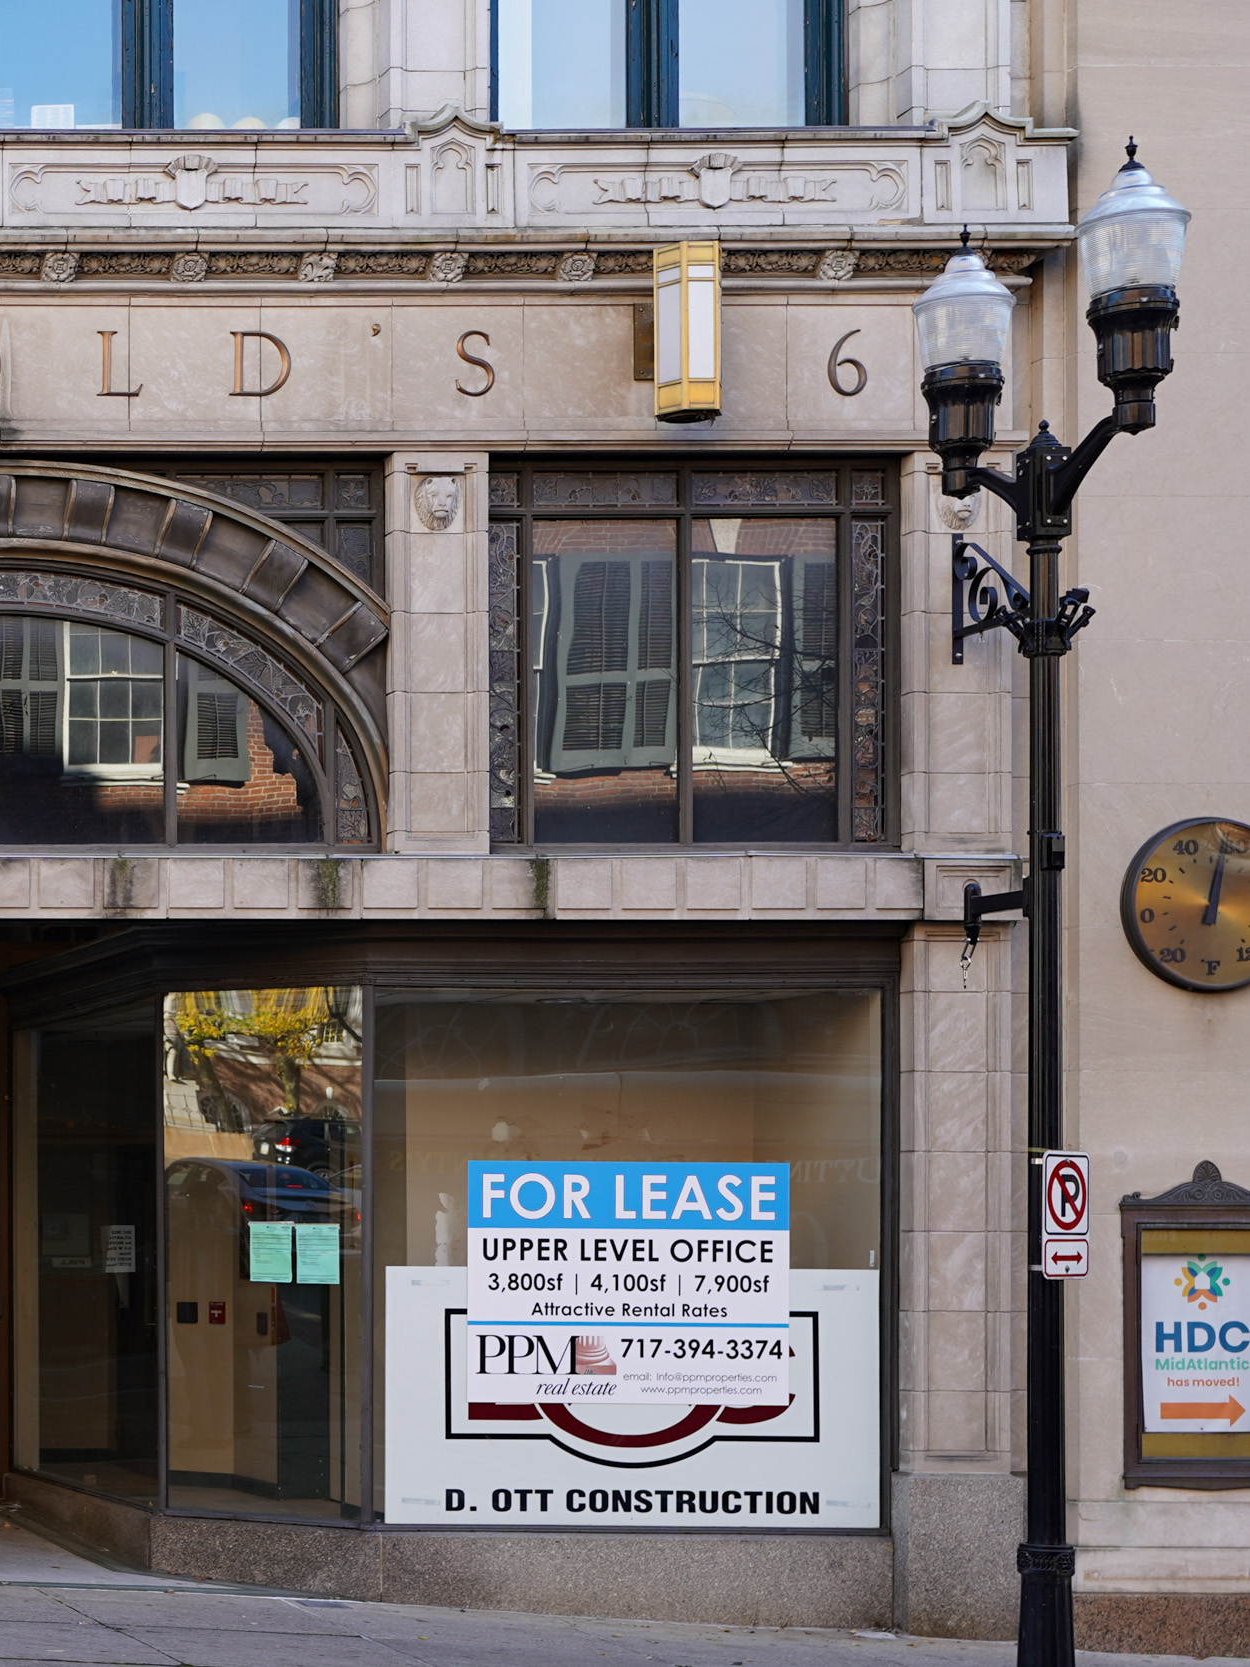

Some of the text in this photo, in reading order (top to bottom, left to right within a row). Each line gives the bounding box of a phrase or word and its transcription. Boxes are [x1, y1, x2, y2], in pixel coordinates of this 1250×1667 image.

[827, 328, 868, 397] 6
[1172, 839, 1199, 856] 40
[1140, 867, 1167, 883] 20
[1140, 908, 1155, 924] 0
[482, 1172, 776, 1221] FOR LEASE
[482, 1237, 773, 1264] UPPER LEVEL OFFICE
[488, 1273, 770, 1295] 3,800sf 4,100sf 7,900sf
[531, 1302, 728, 1318] Attractive Rental Rates
[1155, 1321, 1250, 1354] HDC
[476, 1334, 580, 1375] PPM
[620, 1338, 783, 1360] 717-394-3374
[1155, 1357, 1250, 1371] MidAtlantic
[536, 1377, 618, 1396] real estate
[622, 1372, 778, 1384] email: Info@ppmproperties.com
[1167, 1376, 1240, 1388] has moved!
[640, 1385, 763, 1396] www.ppmproperties.com
[445, 1488, 820, 1515] D. OTT CONSTRUCTION
